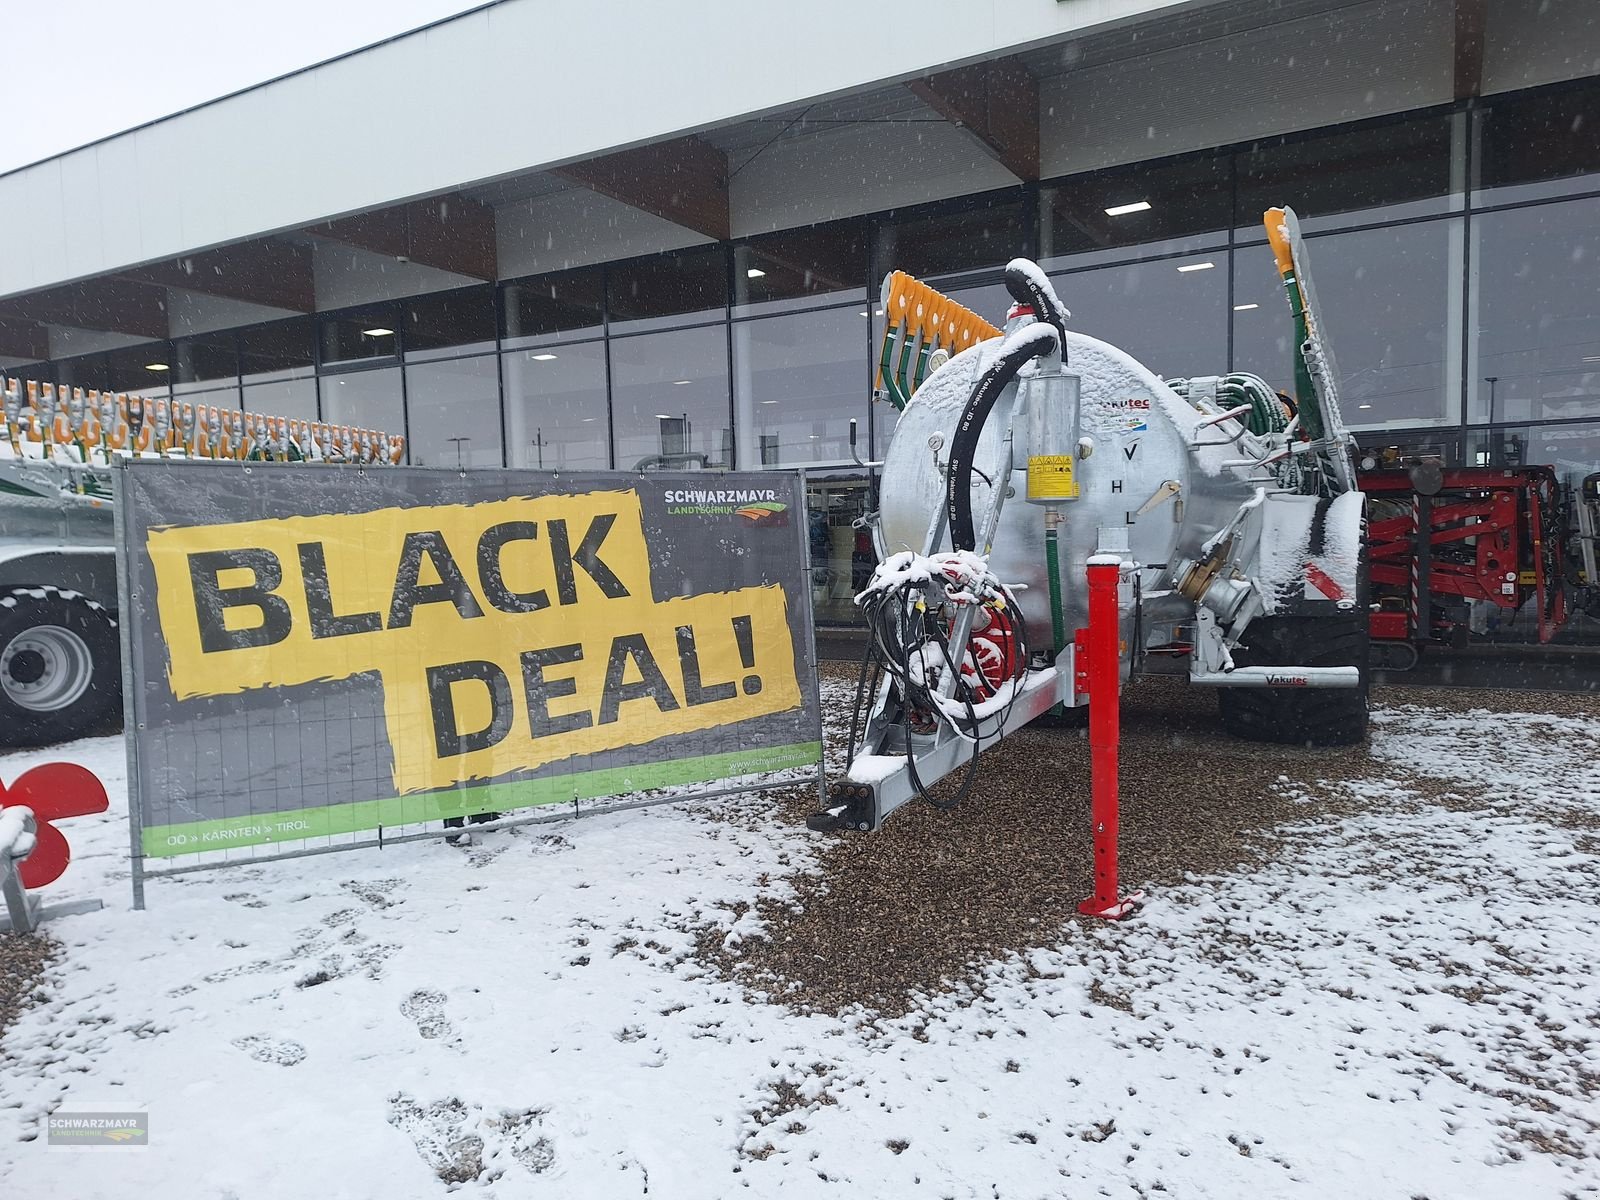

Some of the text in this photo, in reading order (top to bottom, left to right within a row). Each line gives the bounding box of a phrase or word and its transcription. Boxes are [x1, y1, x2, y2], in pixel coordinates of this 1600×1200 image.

[1036, 293, 1050, 319] Vakutec
[972, 377, 994, 406] Vakutec
[966, 411, 975, 421] ID
[961, 421, 970, 432] 80
[1123, 443, 1138, 461] V
[951, 459, 959, 472] SW
[1111, 480, 1122, 494] H
[664, 489, 776, 503] SCHWARZMAYR
[667, 505, 734, 515] LANDTECHNIK
[1126, 511, 1136, 525] L
[187, 514, 630, 653] BLACK
[426, 615, 762, 758] DEAL!
[1266, 674, 1308, 685] Vakutec
[729, 751, 807, 769] www.schwarzmayr.at
[275, 820, 310, 833] TIROL
